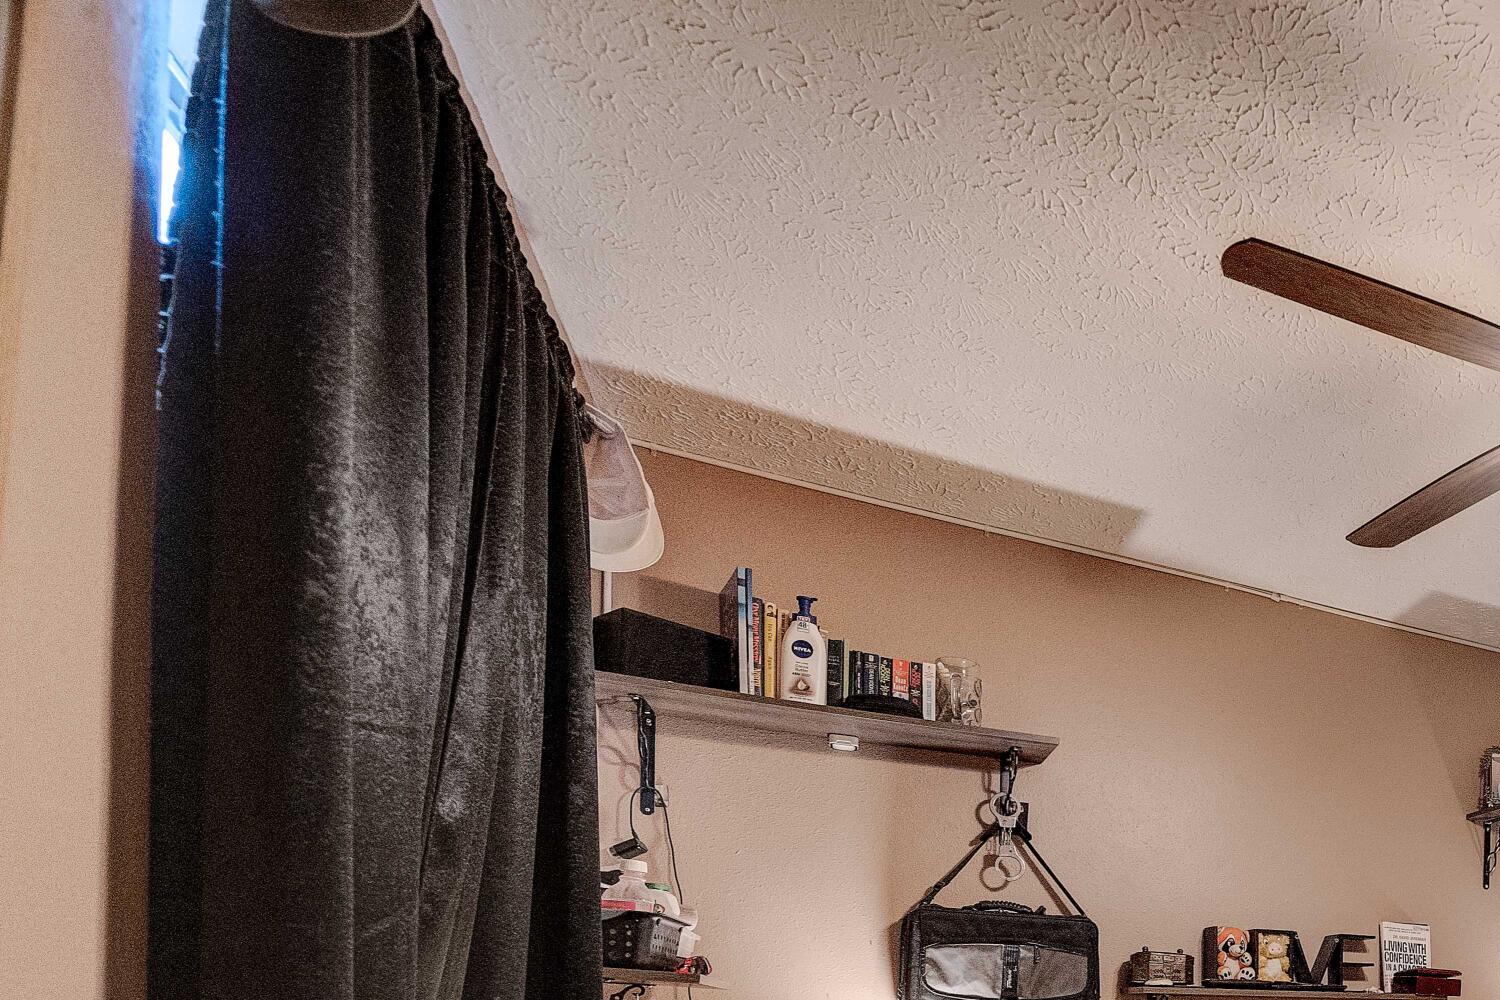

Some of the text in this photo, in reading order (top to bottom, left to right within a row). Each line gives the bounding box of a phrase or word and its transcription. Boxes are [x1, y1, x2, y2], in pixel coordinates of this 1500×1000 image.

[1384, 940, 1427, 954] LIVING WITH
[1384, 952, 1427, 966] CONFIDENCE
